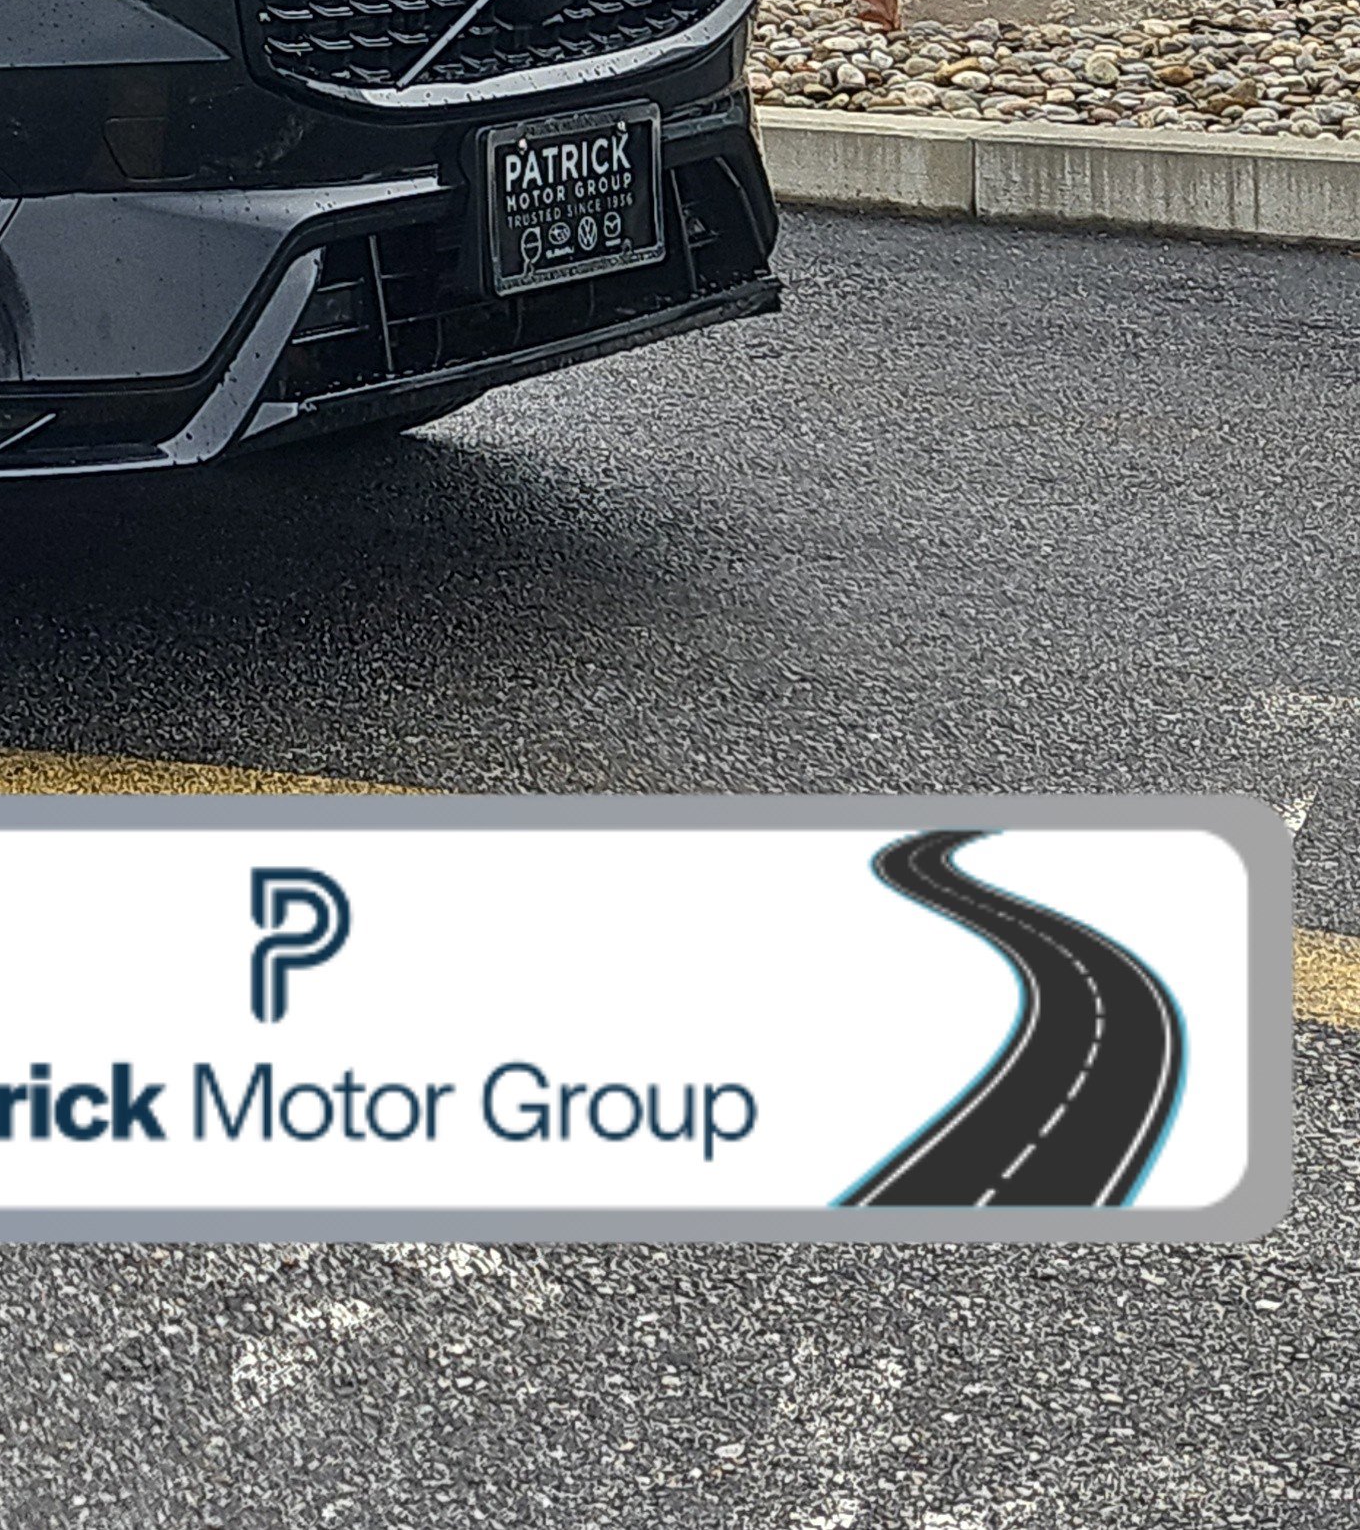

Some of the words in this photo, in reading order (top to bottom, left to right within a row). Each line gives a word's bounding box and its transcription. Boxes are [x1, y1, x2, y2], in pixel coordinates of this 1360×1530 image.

[505, 133, 631, 192] PATRICK
[506, 185, 566, 212] MOTOR
[574, 172, 633, 199] GROUP
[507, 206, 562, 231] TRUSTED
[567, 198, 602, 219] SINCE
